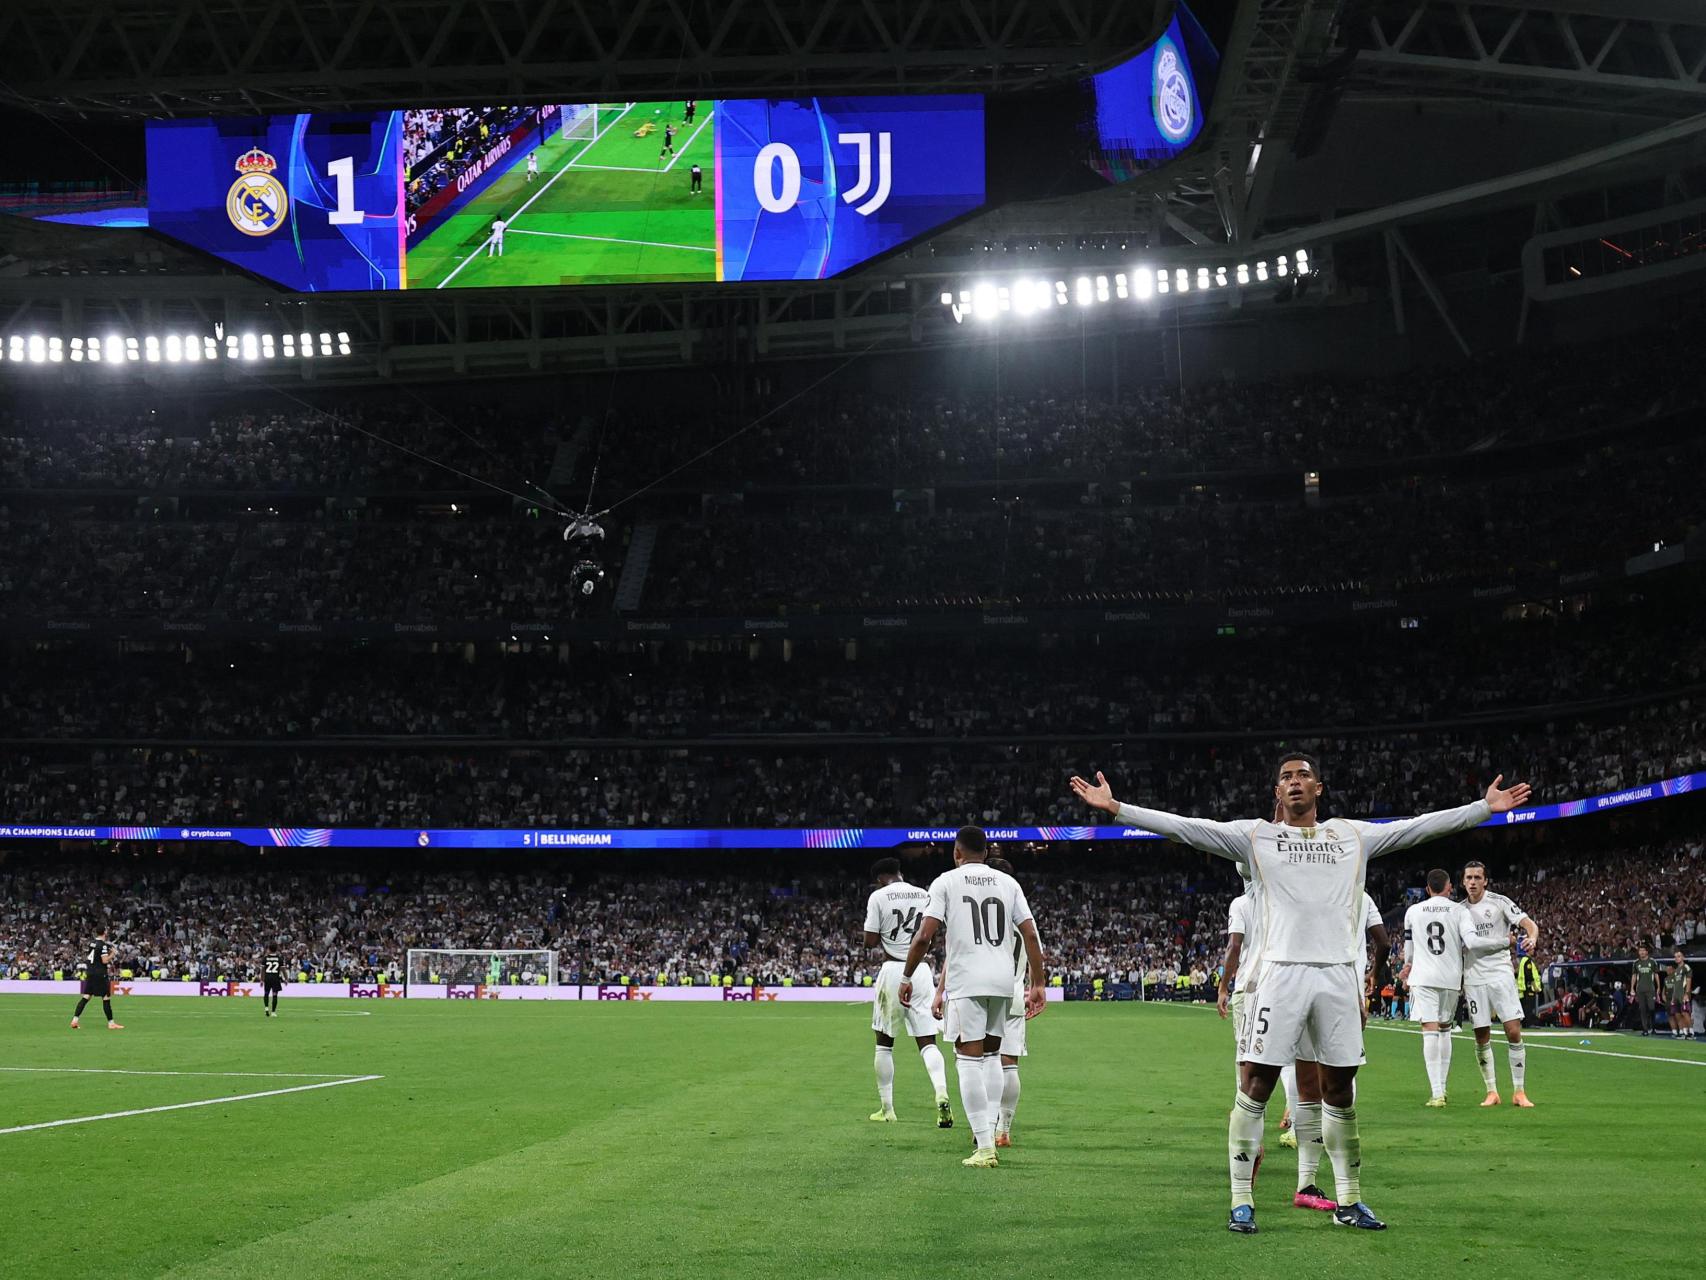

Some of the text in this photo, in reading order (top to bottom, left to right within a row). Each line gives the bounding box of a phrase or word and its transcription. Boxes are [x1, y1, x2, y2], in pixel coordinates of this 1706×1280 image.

[457, 135, 512, 193] QATAR AIRWAYS
[754, 142, 801, 213] 0
[327, 156, 364, 225] 1
[1635, 787, 1652, 800] LEAGUE
[12, 828, 62, 836] CHAMPIONS
[191, 829, 231, 838] crypto.com
[523, 834, 611, 845] 5 BELLINGHAM
[908, 831, 930, 839] UEFA
[985, 830, 1018, 838] LEAGUE
[1277, 840, 1344, 853] Emirates
[1289, 853, 1336, 864] FLY BETTER
[890, 907, 923, 944] 14
[963, 896, 1005, 947] 10
[1427, 921, 1445, 955] 8
[265, 961, 280, 973] 22
[200, 981, 253, 997] FedEx
[349, 983, 403, 998] FedEx
[598, 985, 652, 1000] FedEx
[723, 986, 778, 1001] FedEx
[1470, 1000, 1477, 1015] 8
[1256, 1007, 1270, 1035] 5
